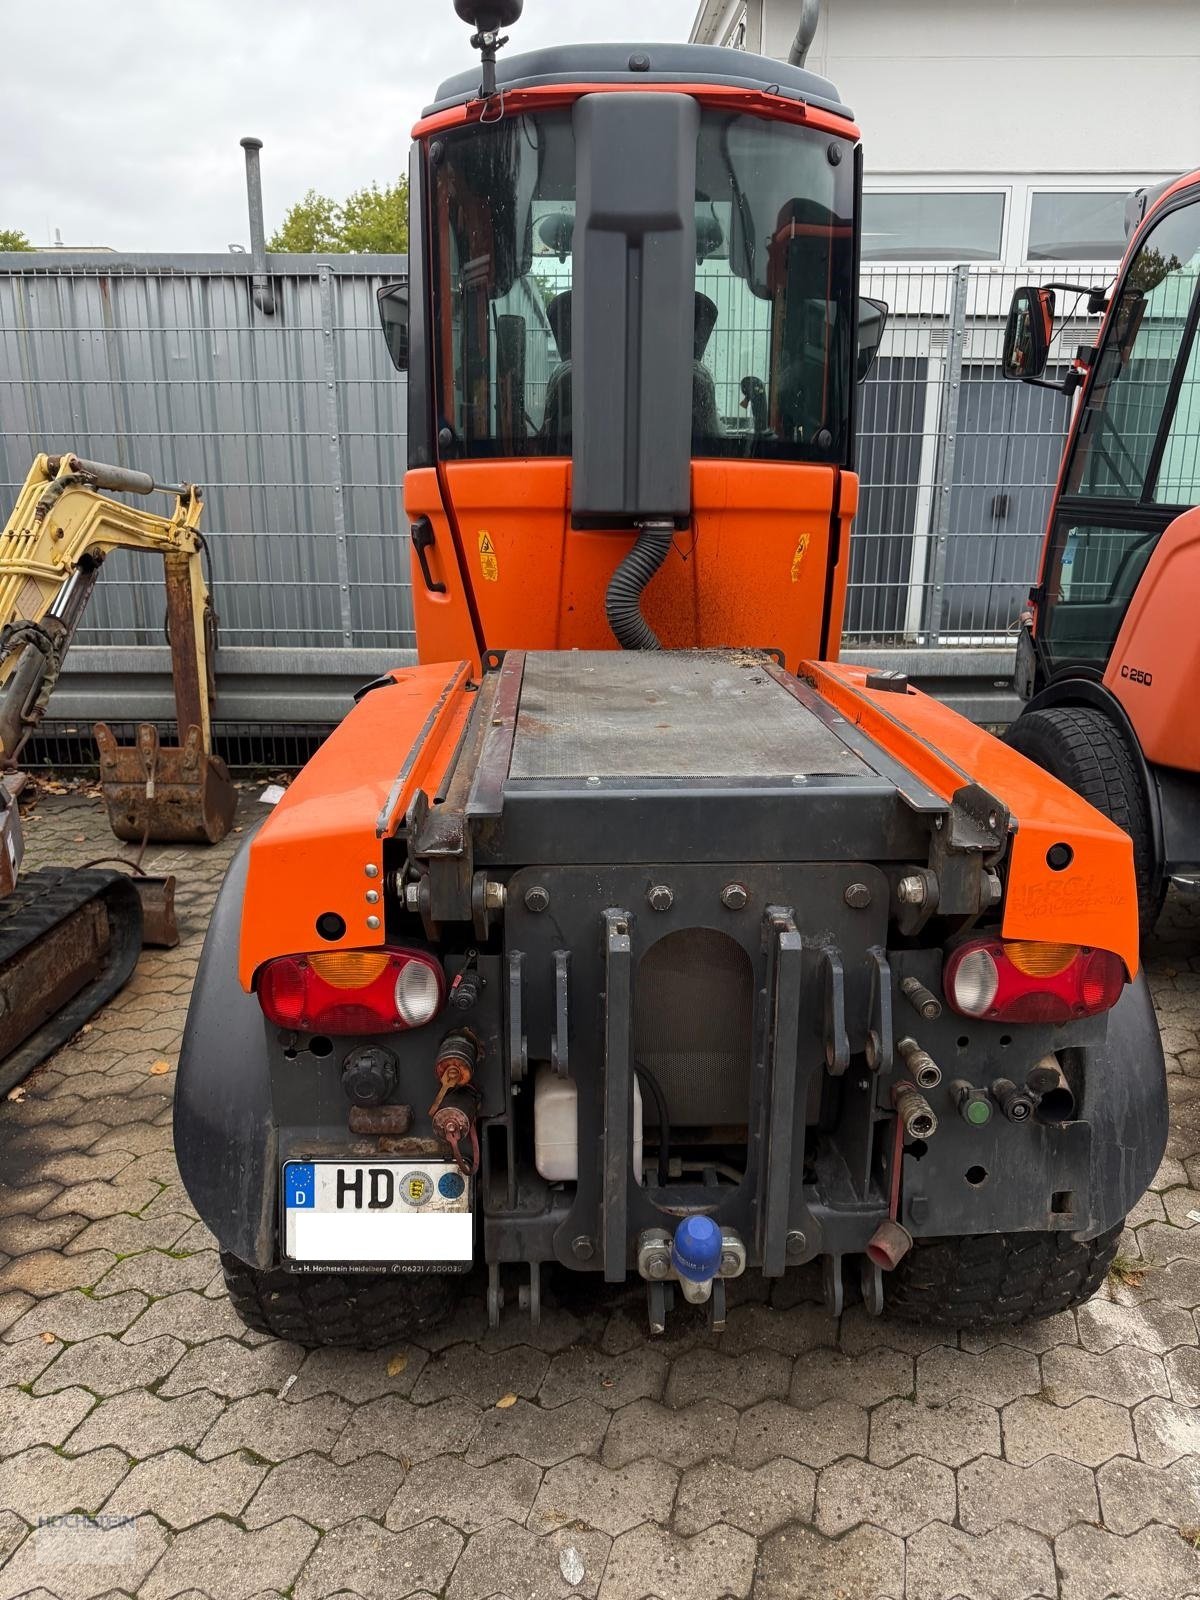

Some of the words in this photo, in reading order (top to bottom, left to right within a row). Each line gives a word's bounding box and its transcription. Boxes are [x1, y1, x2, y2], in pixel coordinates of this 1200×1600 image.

[1121, 665, 1129, 678] C
[1129, 668, 1153, 686] 250
[336, 1168, 394, 1209] HD
[296, 1191, 306, 1205] D
[348, 1265, 387, 1274] Heidelberg
